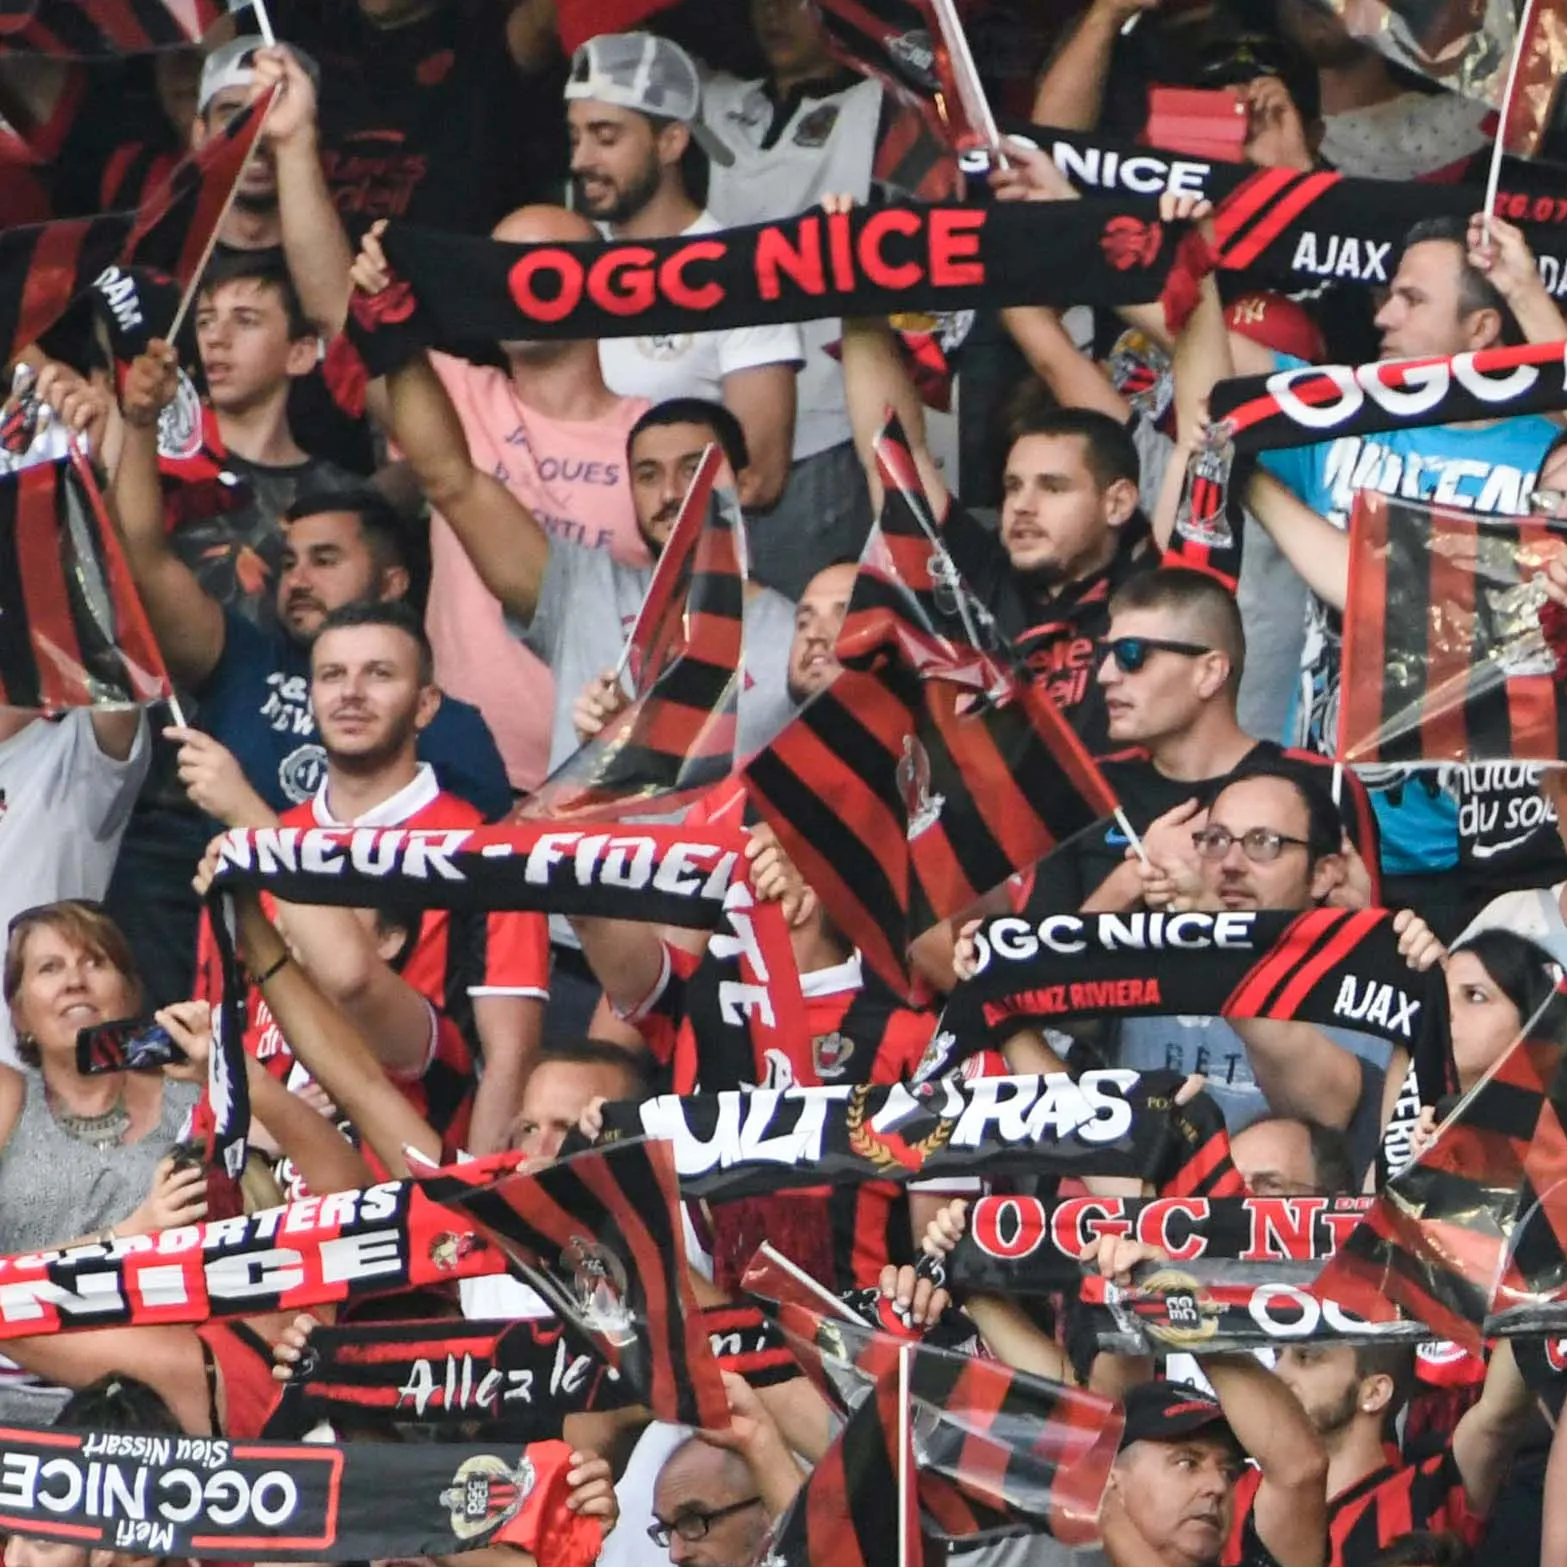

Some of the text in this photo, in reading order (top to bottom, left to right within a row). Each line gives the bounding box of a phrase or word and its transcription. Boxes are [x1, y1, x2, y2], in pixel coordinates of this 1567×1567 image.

[1053, 140, 1212, 202] NICE
[507, 208, 987, 323] OGC NICE
[1291, 230, 1394, 282] AJAX
[1266, 348, 1539, 430] OGC
[1457, 797, 1507, 838] du
[1098, 910, 1256, 953] NICE
[1069, 977, 1161, 1009] RIVIERA
[1333, 974, 1421, 1037] AJAX
[972, 1195, 1210, 1260] OGC
[0, 1229, 401, 1321] NICE
[399, 1356, 534, 1414] Allez
[82, 1432, 229, 1468] Sieu Nissart
[2, 1452, 298, 1526] OGC NICE
